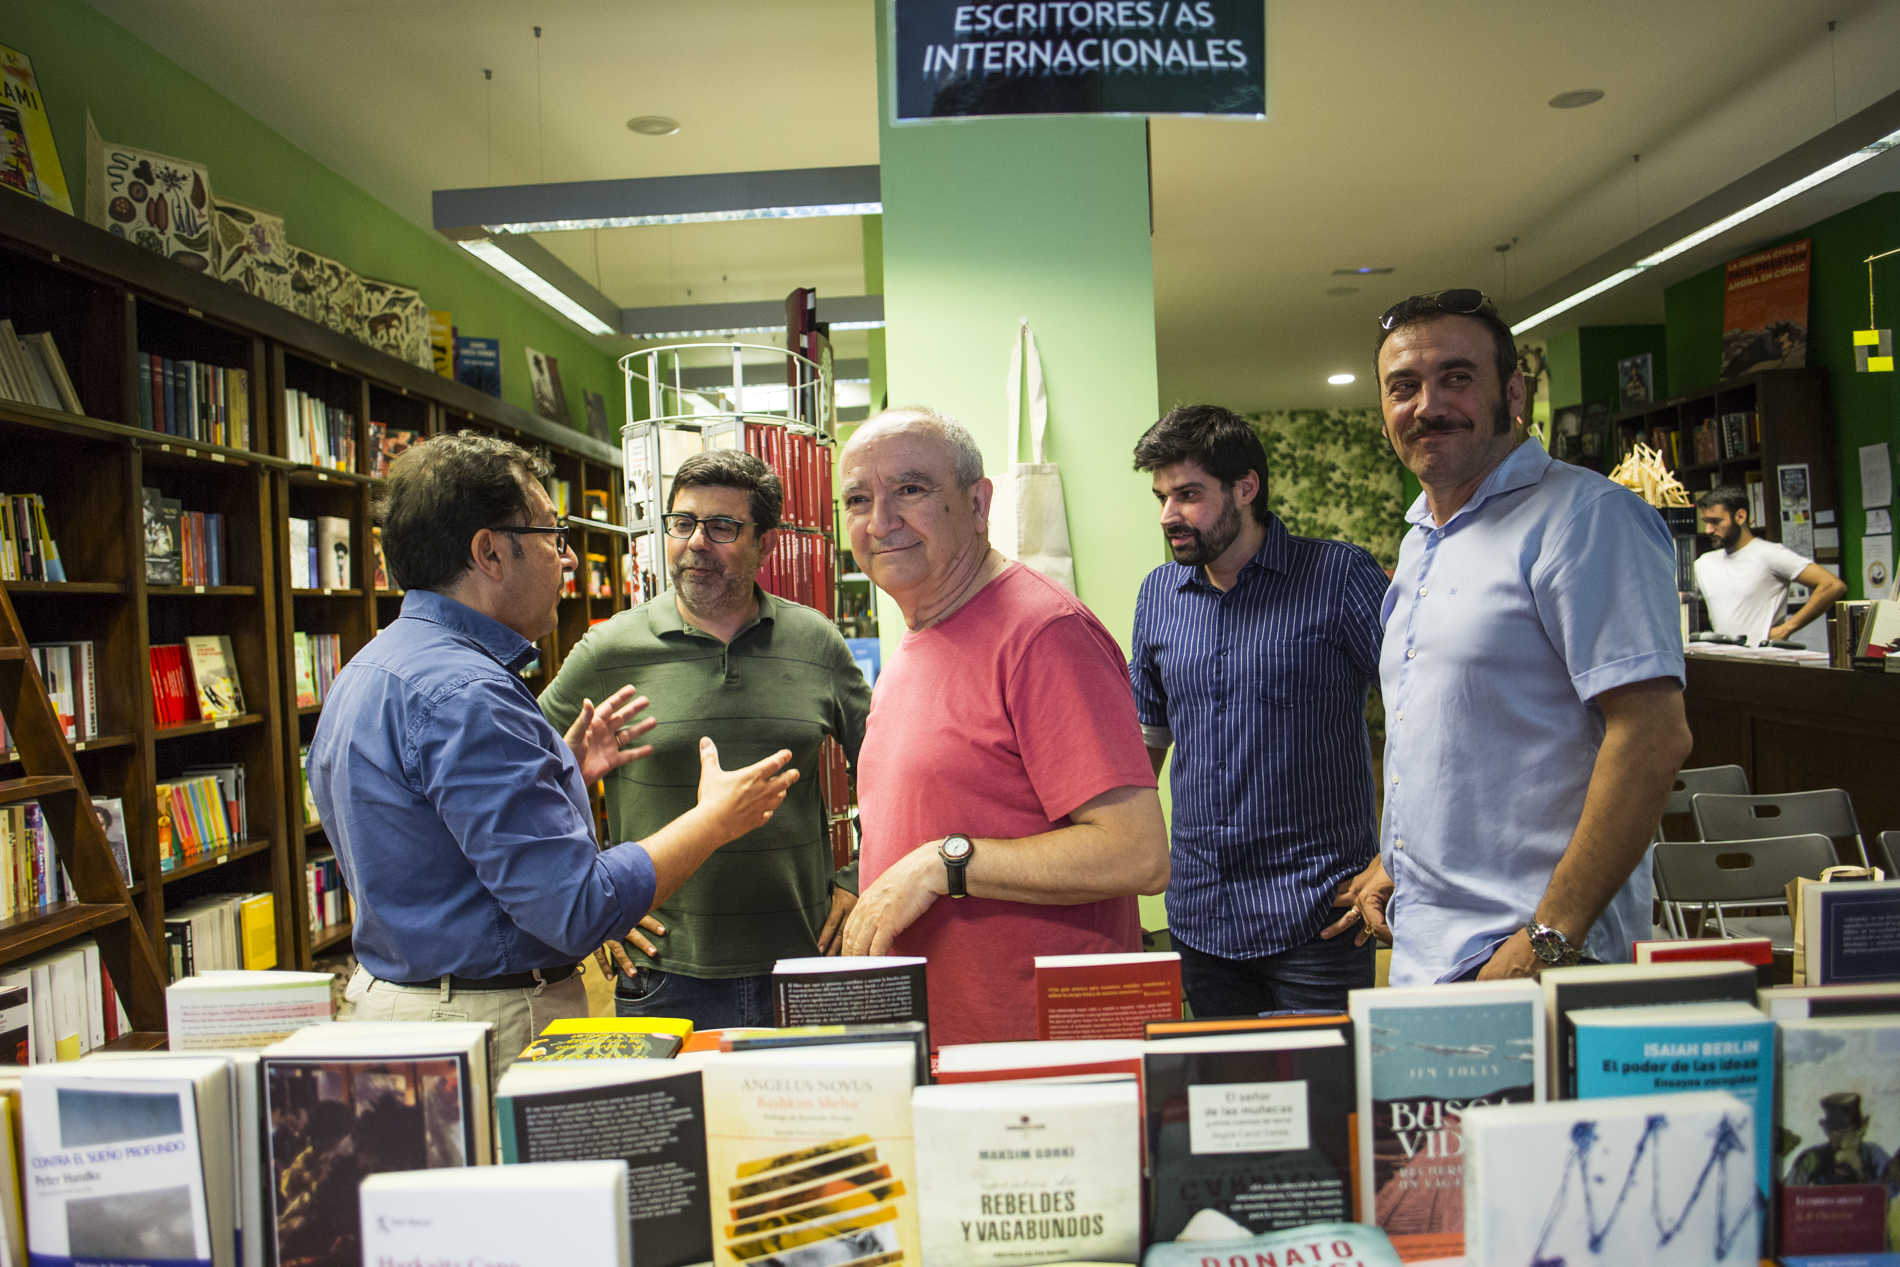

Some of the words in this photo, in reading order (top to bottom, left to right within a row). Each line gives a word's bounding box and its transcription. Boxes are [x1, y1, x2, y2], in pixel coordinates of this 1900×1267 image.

[954, 1, 1215, 31] ESCRITORES/AS
[923, 38, 1248, 73] INTERNACIONALES
[0, 80, 39, 111] AMI
[1643, 1043, 1699, 1057] ISAIAH
[1702, 1040, 1760, 1056] BERLIN
[1602, 1060, 1617, 1073] El
[1621, 1059, 1666, 1074] poder
[1671, 1059, 1689, 1073] de
[1693, 1058, 1714, 1072] las
[1719, 1057, 1758, 1071] ideas
[817, 1079, 873, 1092] NOVUS
[32, 1155, 72, 1169] CONTRA
[73, 1153, 85, 1166] EL
[87, 1147, 122, 1165] SUEÑO
[125, 1141, 186, 1160] PROFUNDO
[1396, 1131, 1465, 1158] VID
[34, 1173, 60, 1187] Peter
[981, 1190, 1076, 1215] REBELDES
[961, 1220, 973, 1243] Y
[975, 1213, 1104, 1243] VAGABUNDOS
[1200, 1240, 1353, 1267] DONATO
